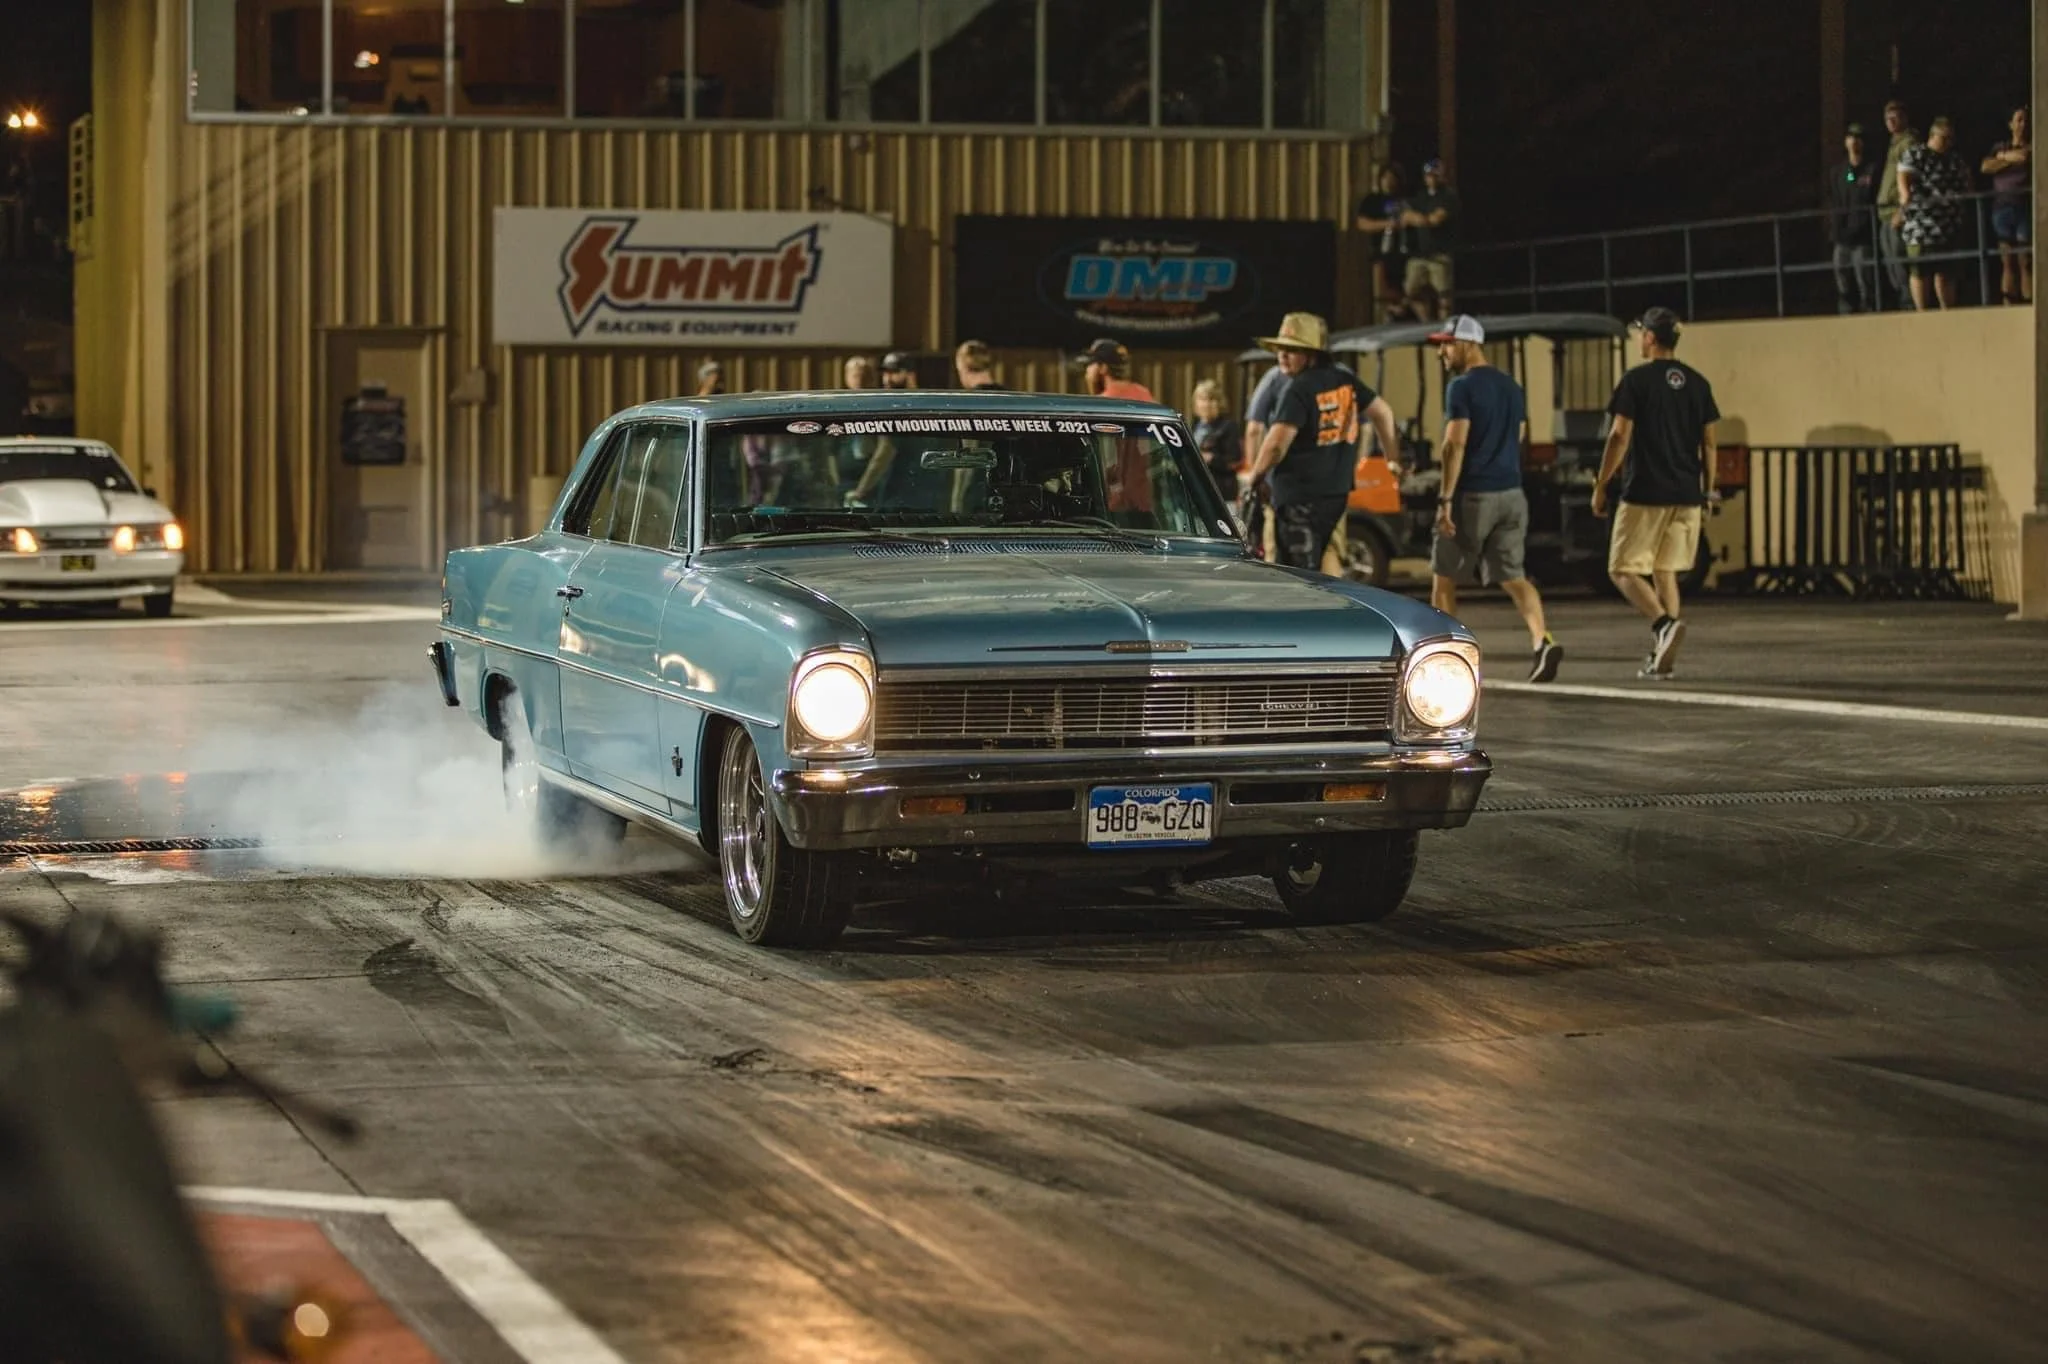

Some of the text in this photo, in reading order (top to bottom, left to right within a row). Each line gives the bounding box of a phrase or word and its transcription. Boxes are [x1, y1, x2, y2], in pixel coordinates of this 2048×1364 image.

[1065, 256, 1237, 301] DMP
[595, 319, 797, 336] RACING EQUIPMENT
[844, 421, 894, 434] ROCKY
[896, 419, 972, 433] MOUNTAIN
[974, 419, 1010, 432] RACE
[1011, 420, 1052, 433] WEEK
[1056, 421, 1092, 434] 2021
[1146, 423, 1183, 448] 19
[1125, 788, 1180, 798] COLORADO
[1096, 801, 1205, 832] 988 GZQ
